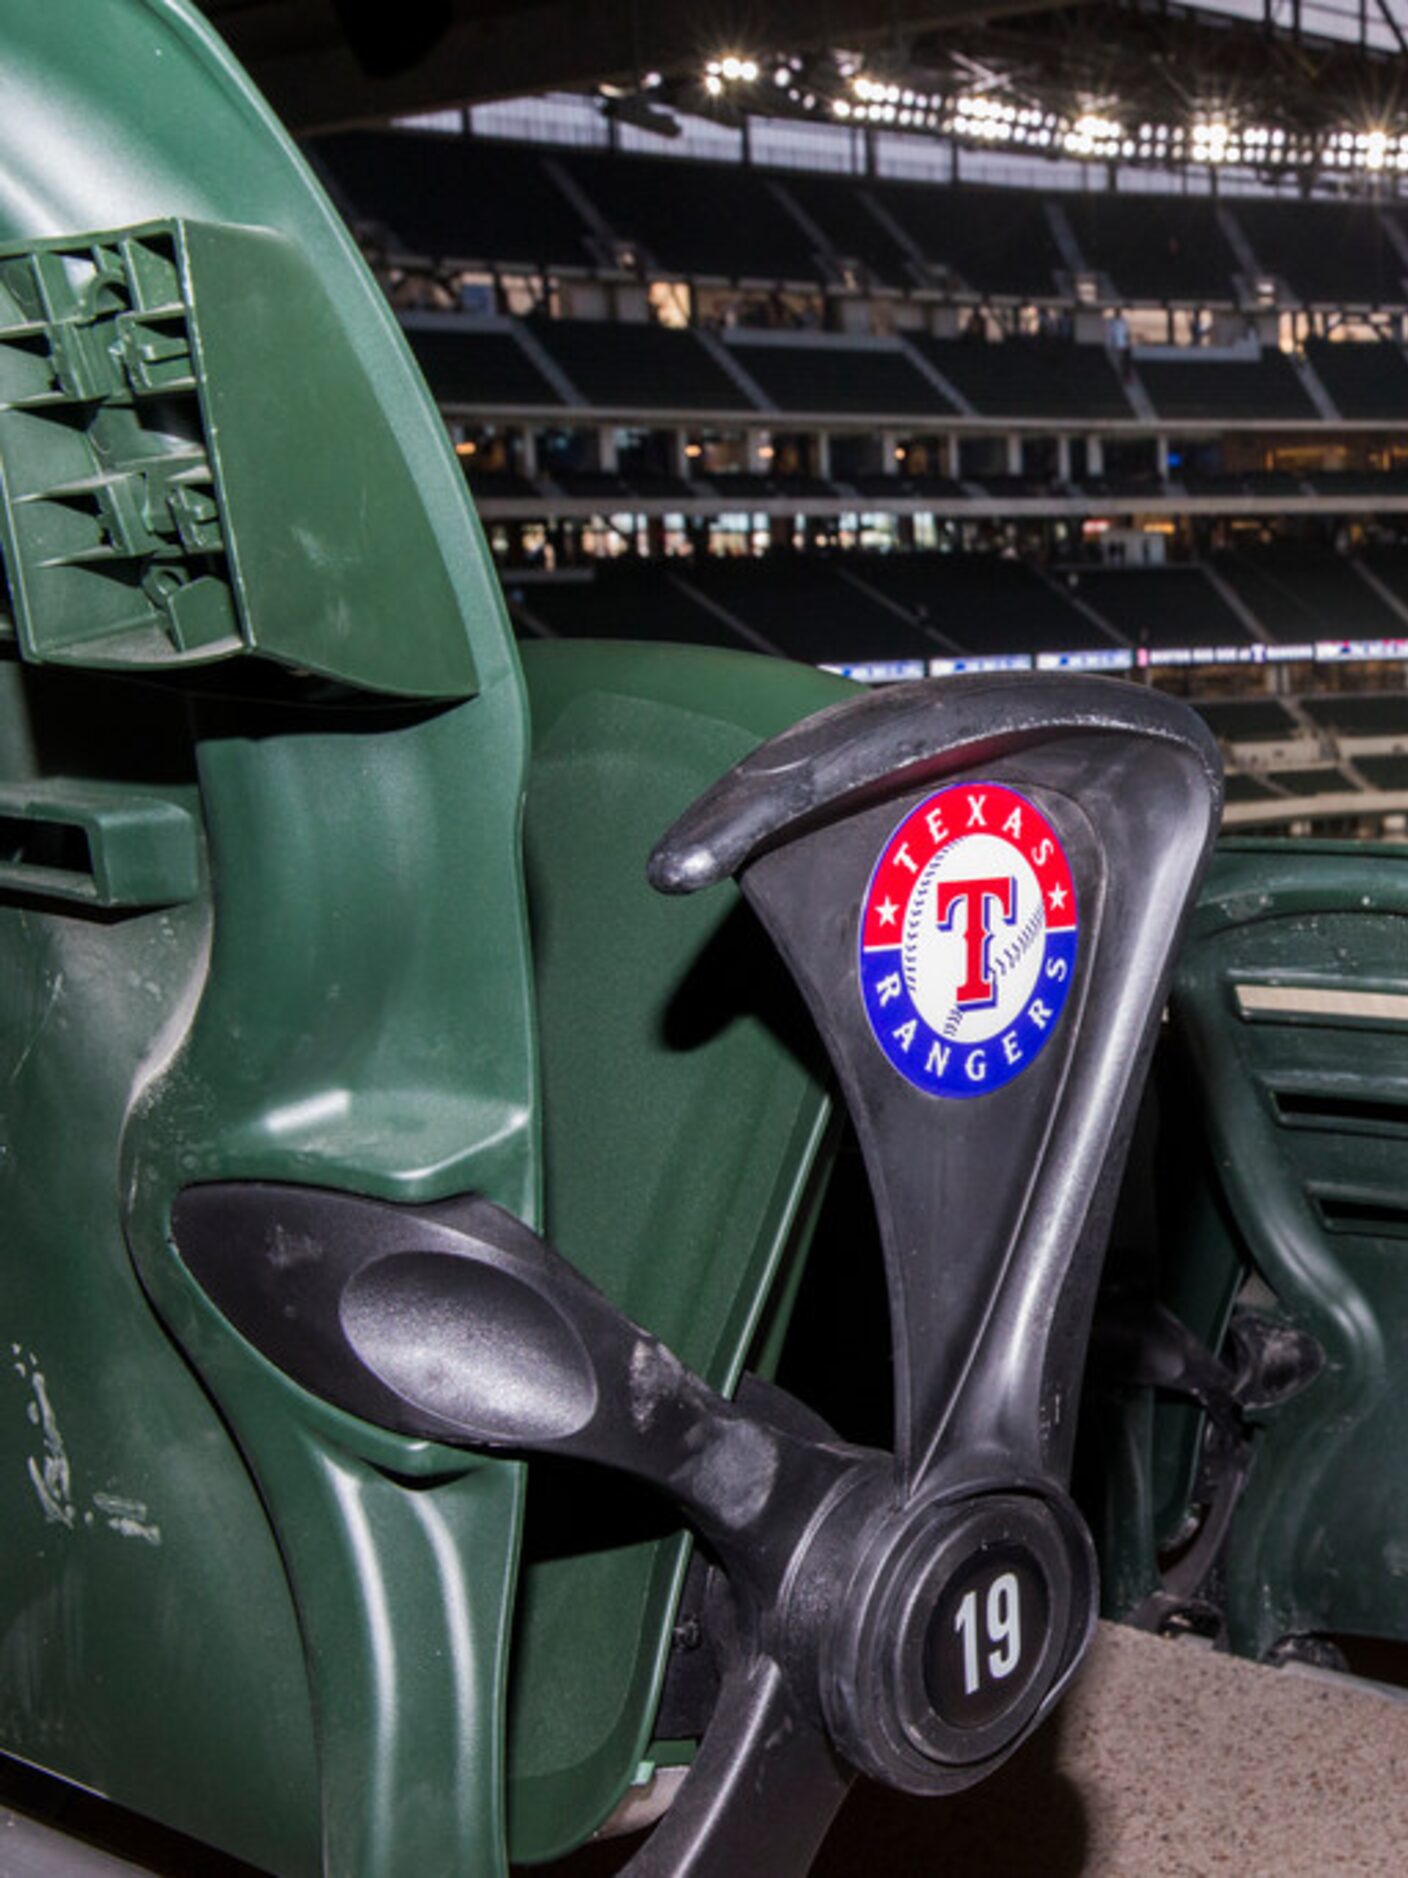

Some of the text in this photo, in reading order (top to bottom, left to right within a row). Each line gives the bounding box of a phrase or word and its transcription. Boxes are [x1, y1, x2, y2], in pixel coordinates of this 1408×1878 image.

[892, 794, 1055, 875] TEXAS
[935, 875, 1019, 1014] T
[875, 957, 1069, 1082] RANGERS
[954, 1571, 1022, 1696] 19
